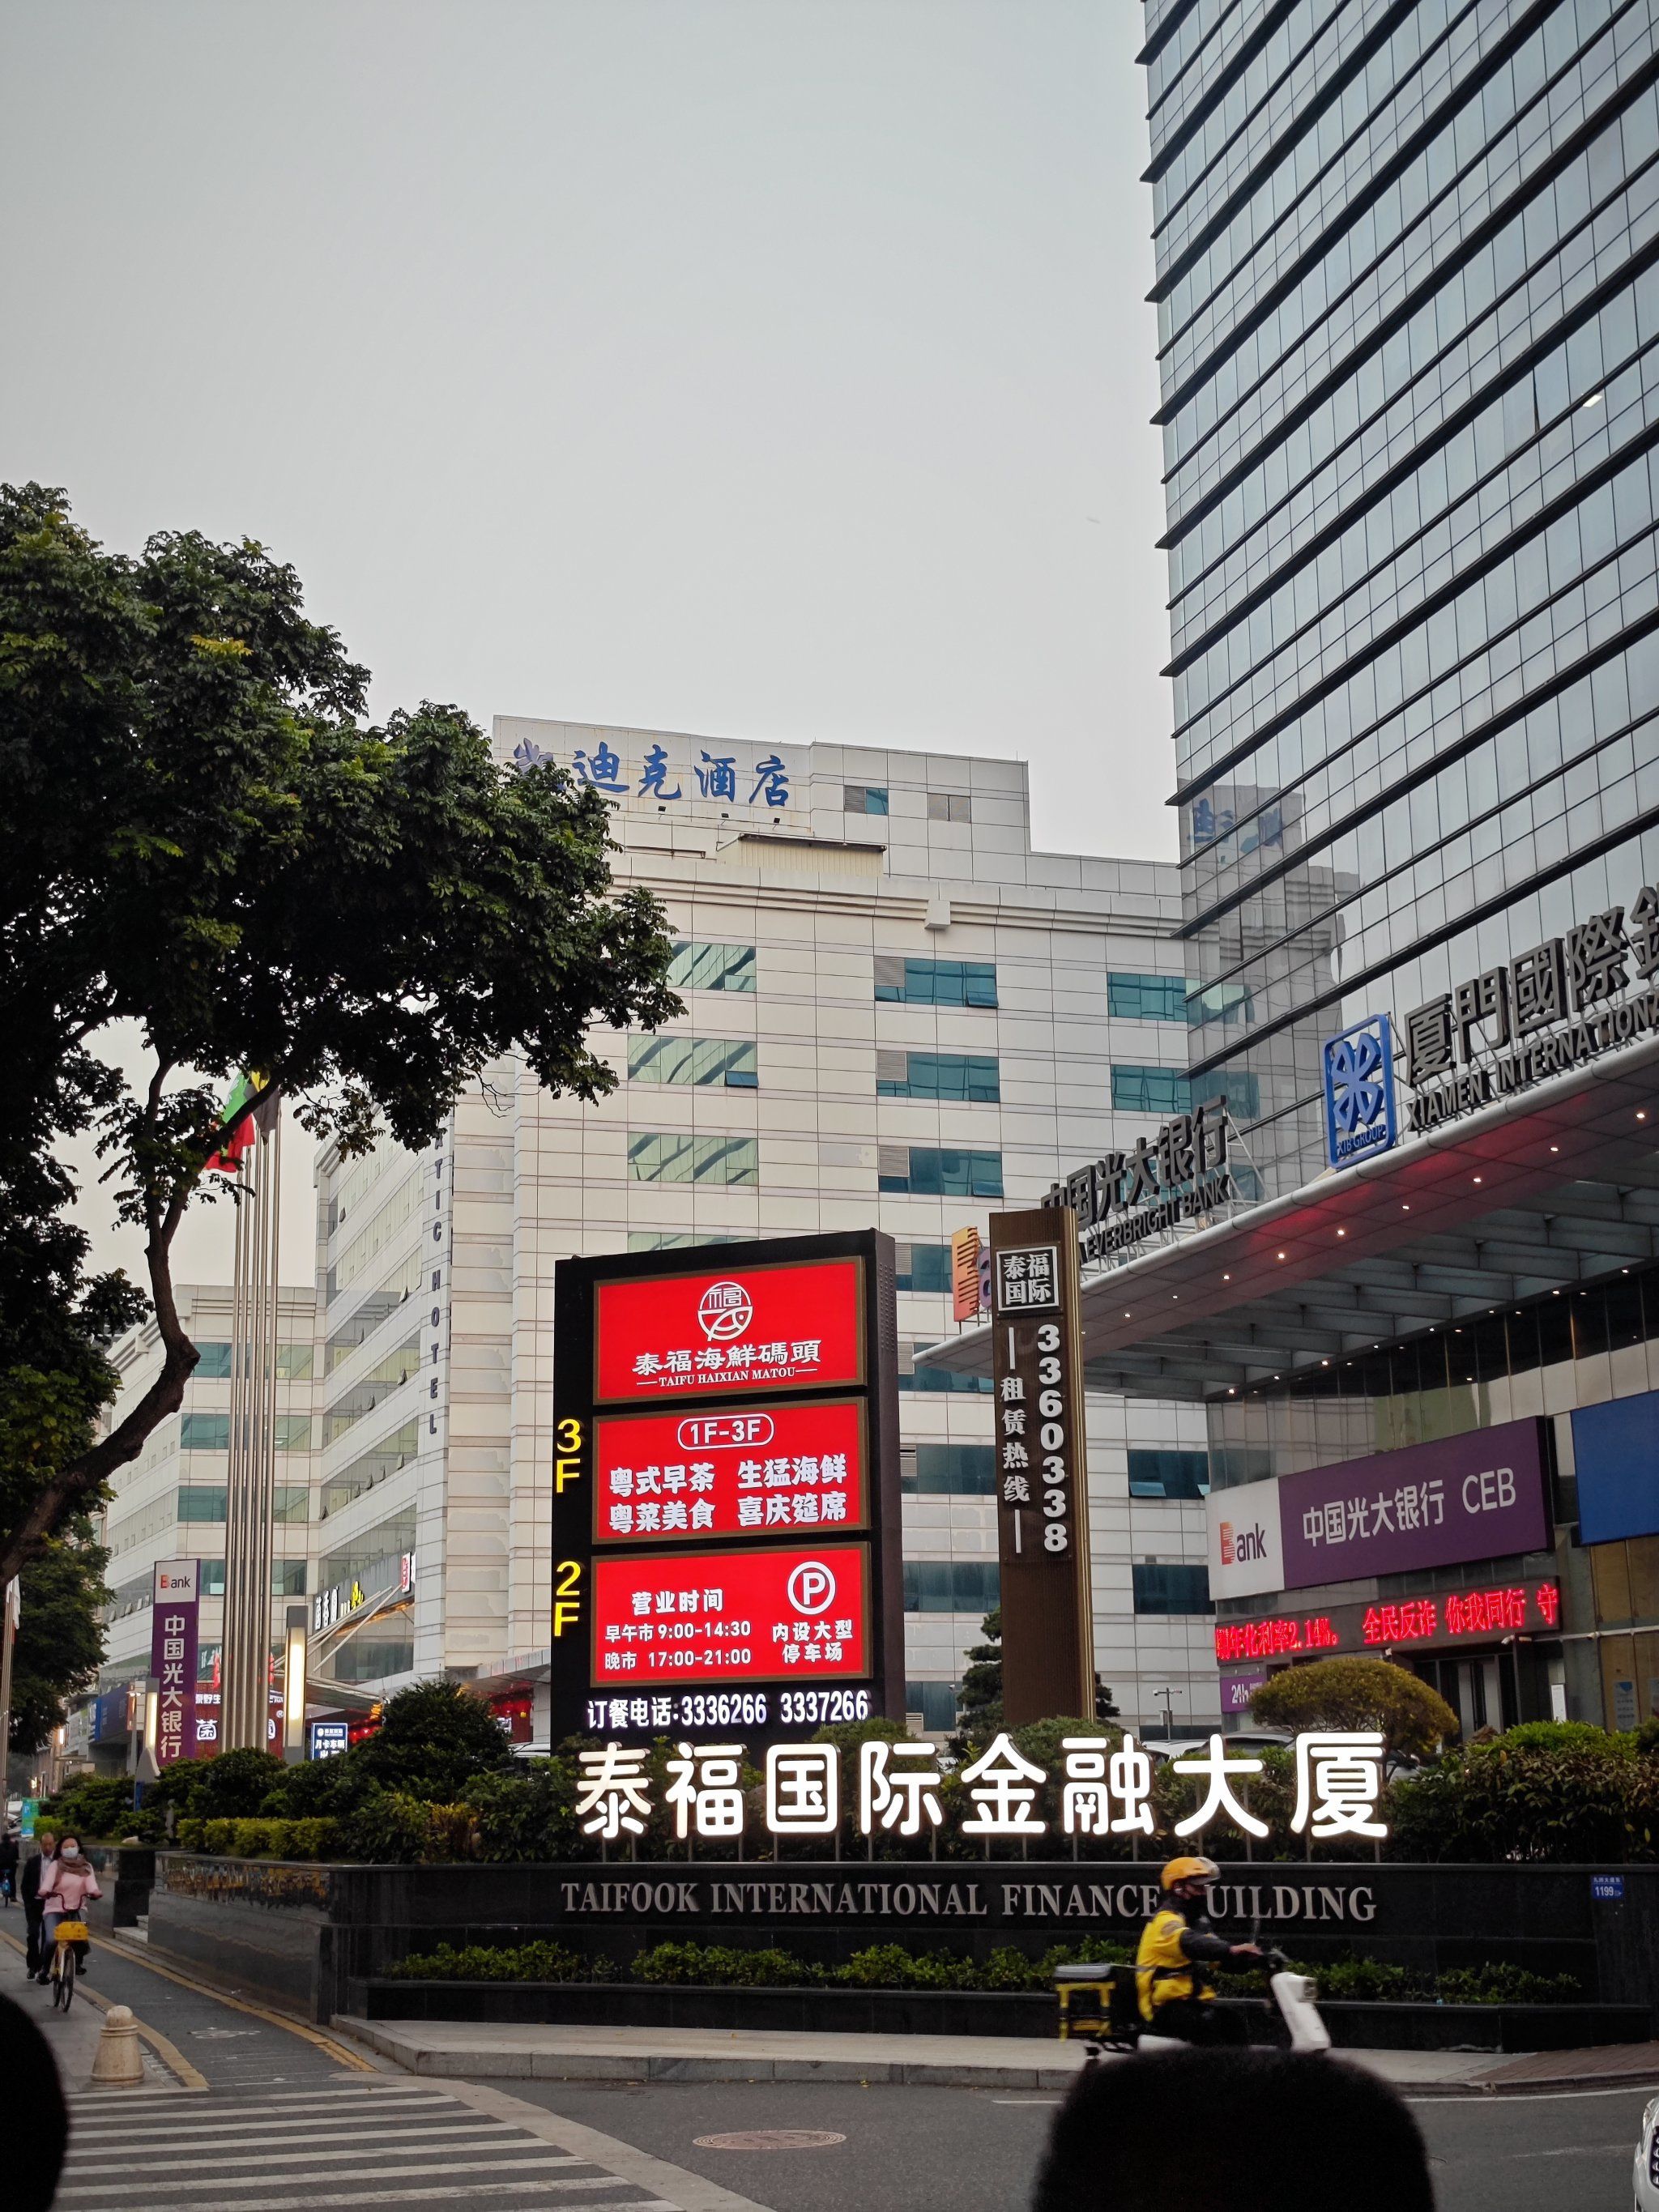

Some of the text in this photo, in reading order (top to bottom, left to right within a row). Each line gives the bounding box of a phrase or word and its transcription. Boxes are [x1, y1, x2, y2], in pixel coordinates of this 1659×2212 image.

[1405, 1070, 1490, 1132] XIAMEN
[1337, 1123, 1385, 1155] XIB GROUP
[1086, 1174, 1230, 1262] EVERBRIGHT BANK
[1003, 1253, 1050, 1280] 泰福
[1004, 1278, 1051, 1305] 国际
[429, 1269, 441, 1434] HOTEL
[632, 1340, 821, 1376] 泰福海鮮碼頭
[659, 1366, 795, 1387] TAIFU HAIXIAN MATOU
[689, 1418, 761, 1445] 1F-3F
[1000, 1375, 1031, 1503] 租赁热线
[1037, 1324, 1068, 1553] 3360338
[557, 1418, 582, 1494] 3F
[609, 1454, 847, 1498] 粤式早茶 生猛海鲜
[609, 1490, 847, 1534] 粤菜美食 喜庆筵席
[1303, 1467, 1516, 1547] 中国光大银行 CEB
[554, 1561, 582, 1636] 2F
[631, 1588, 724, 1617] 营业时间
[1362, 1599, 1437, 1643] 全民反诈
[1445, 1588, 1526, 1634] 你我同行
[605, 1620, 751, 1643] 早午市 9:00-14:30
[772, 1619, 855, 1643] 内设大型
[605, 1647, 751, 1670] 晚市 17:00-21:00
[783, 1643, 842, 1664] 停车场
[160, 1614, 186, 1758] 中国光大银行
[780, 1690, 869, 1724] 3337266
[575, 1732, 1388, 1839] 泰福国际金融大厦
[561, 1881, 1377, 1922] TAIFOOK INTERNATIONAL FINANCE UILDING
